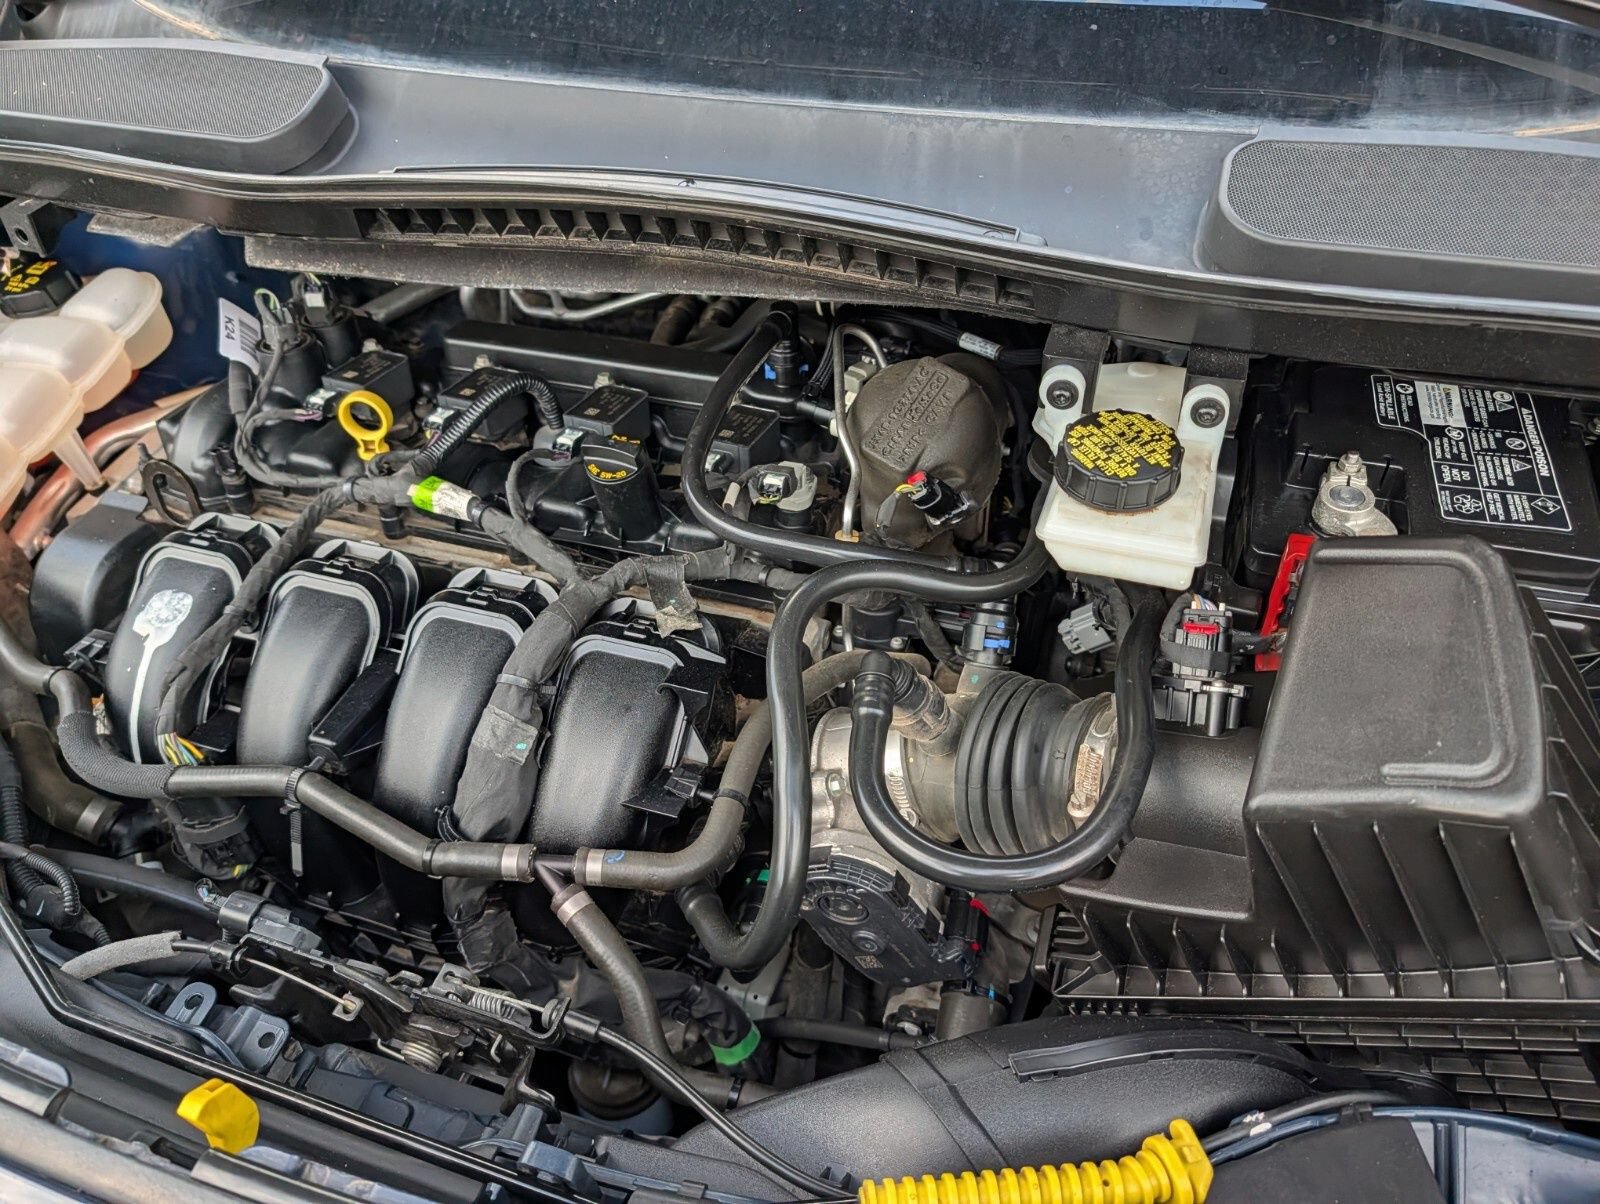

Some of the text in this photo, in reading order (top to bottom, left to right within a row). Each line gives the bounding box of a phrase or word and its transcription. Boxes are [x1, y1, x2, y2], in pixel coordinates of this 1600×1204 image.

[224, 315, 236, 341] K24
[1382, 381, 1395, 419] NON-SPILLABLE
[1399, 394, 1409, 422] INSTRUCTIONS
[1441, 437, 1450, 451] REACH
[1457, 441, 1468, 461] KEEP OUT
[1522, 414, 1550, 476] DANGER/POISON
[587, 463, 627, 479] SAE 5W-20
[1450, 468, 1461, 481] NOT
[1460, 470, 1471, 480] DO
[1492, 492, 1500, 501] GET
